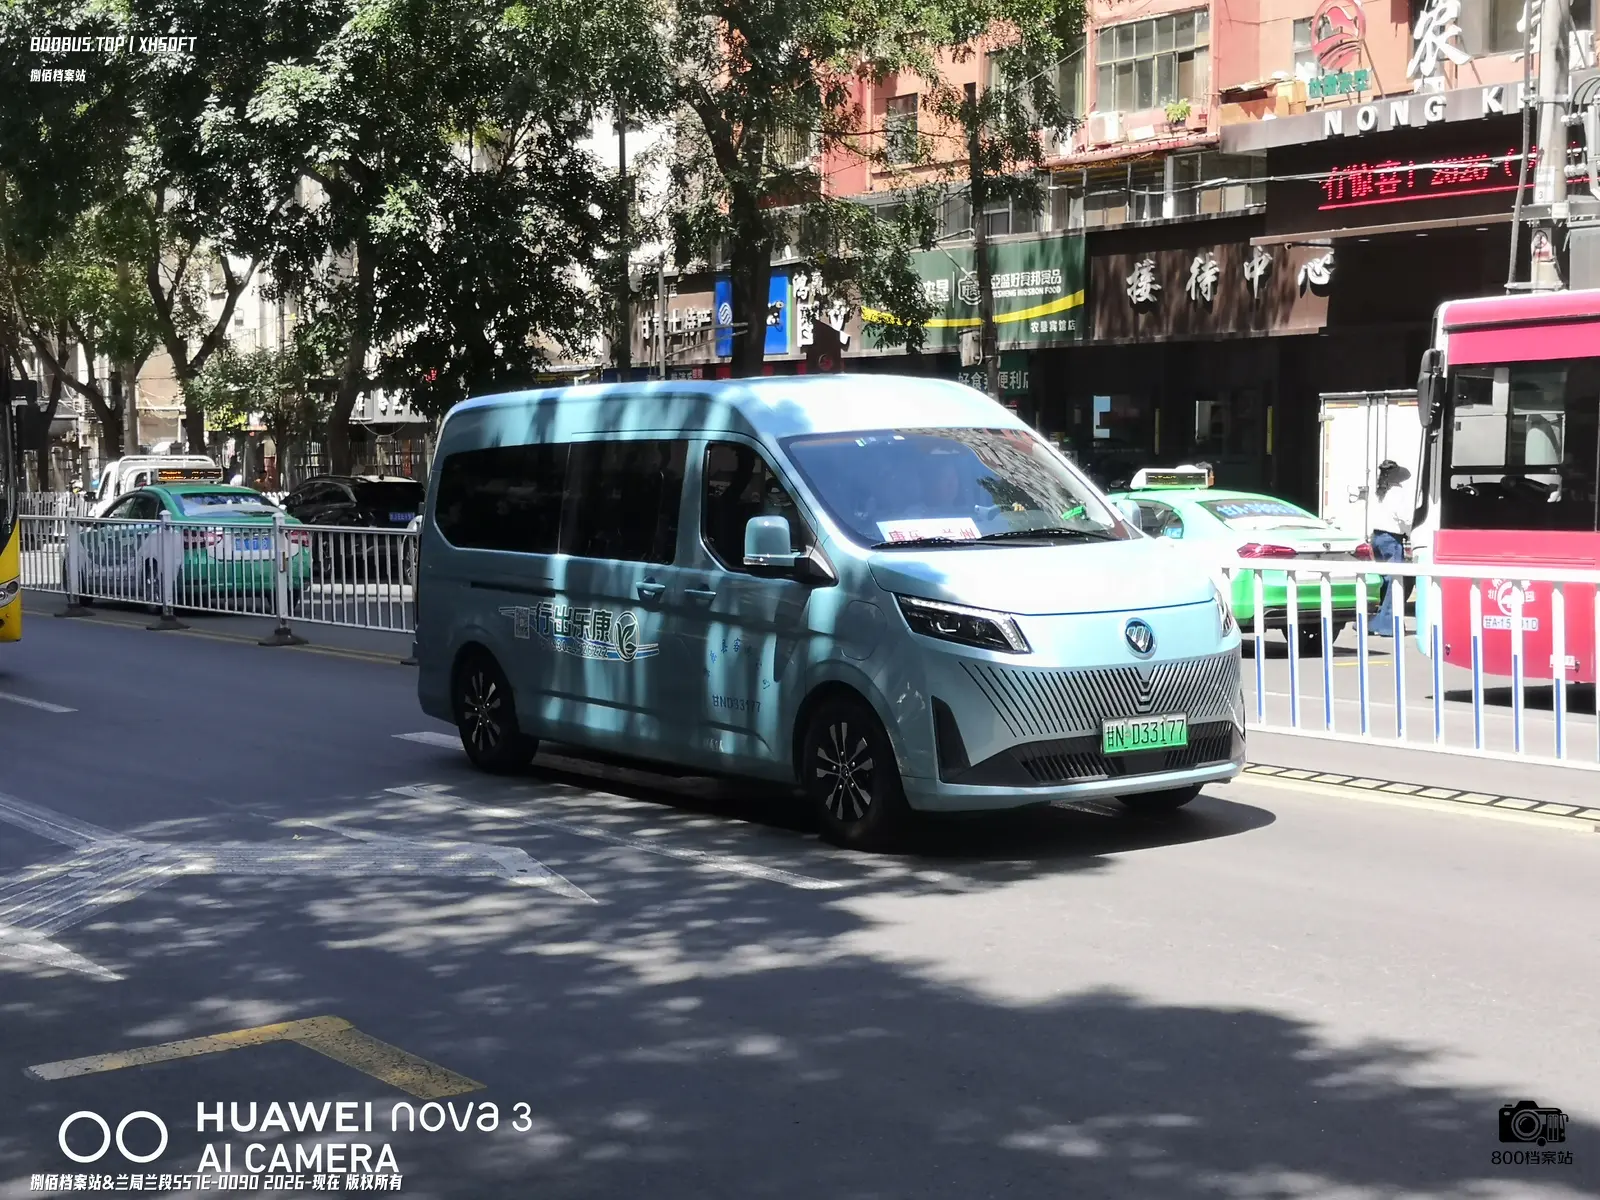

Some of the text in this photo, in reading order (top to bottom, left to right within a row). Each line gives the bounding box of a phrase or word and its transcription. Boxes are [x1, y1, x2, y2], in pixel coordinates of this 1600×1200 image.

[1323, 96, 1447, 136] NONG
[1044, 285, 1062, 295] FOOD
[1126, 245, 1335, 305] 接待中心
